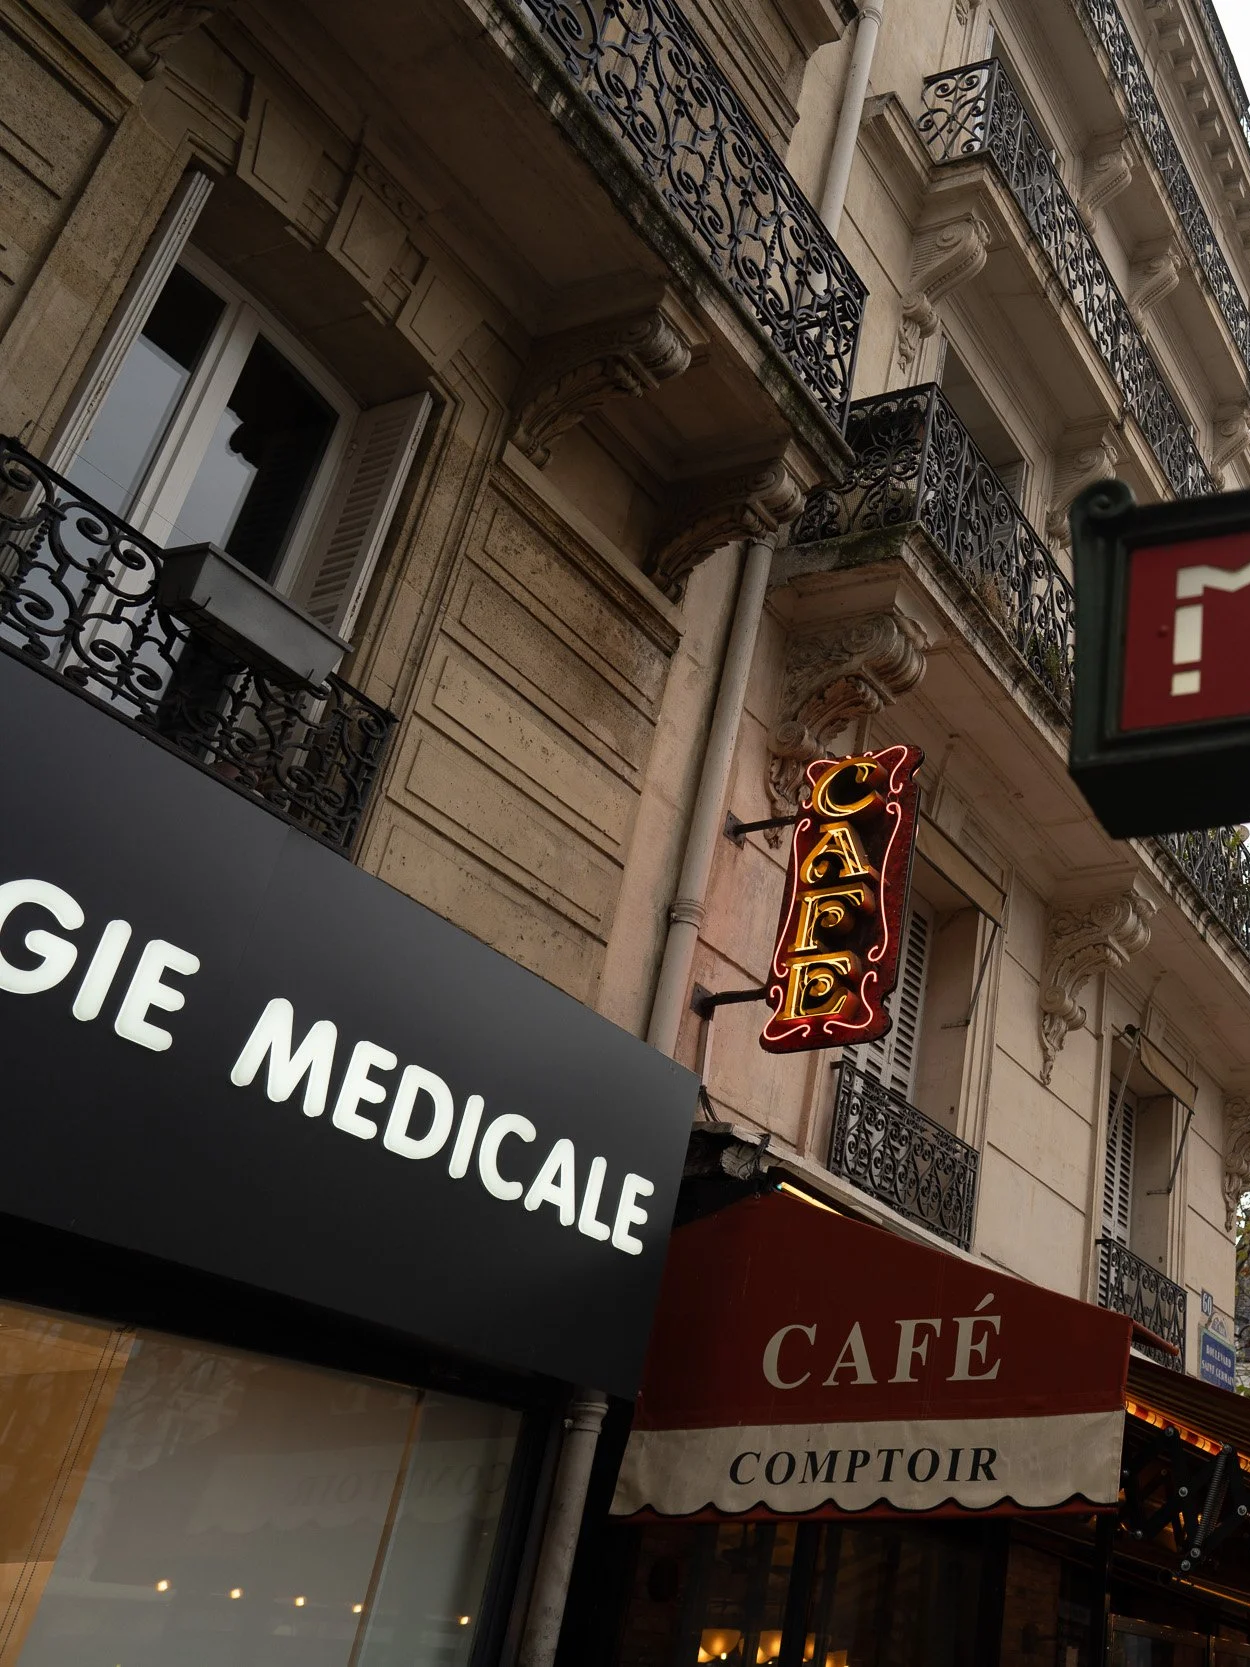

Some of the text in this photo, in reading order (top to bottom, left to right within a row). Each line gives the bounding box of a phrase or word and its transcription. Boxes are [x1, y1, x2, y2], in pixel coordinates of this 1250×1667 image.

[776, 756, 888, 1022] CAFE
[0, 878, 655, 1256] GIE MEDICALE
[761, 1292, 1002, 1390] CAFÉ
[1202, 1293, 1212, 1316] 60
[728, 1446, 999, 1486] COMPTOIR
